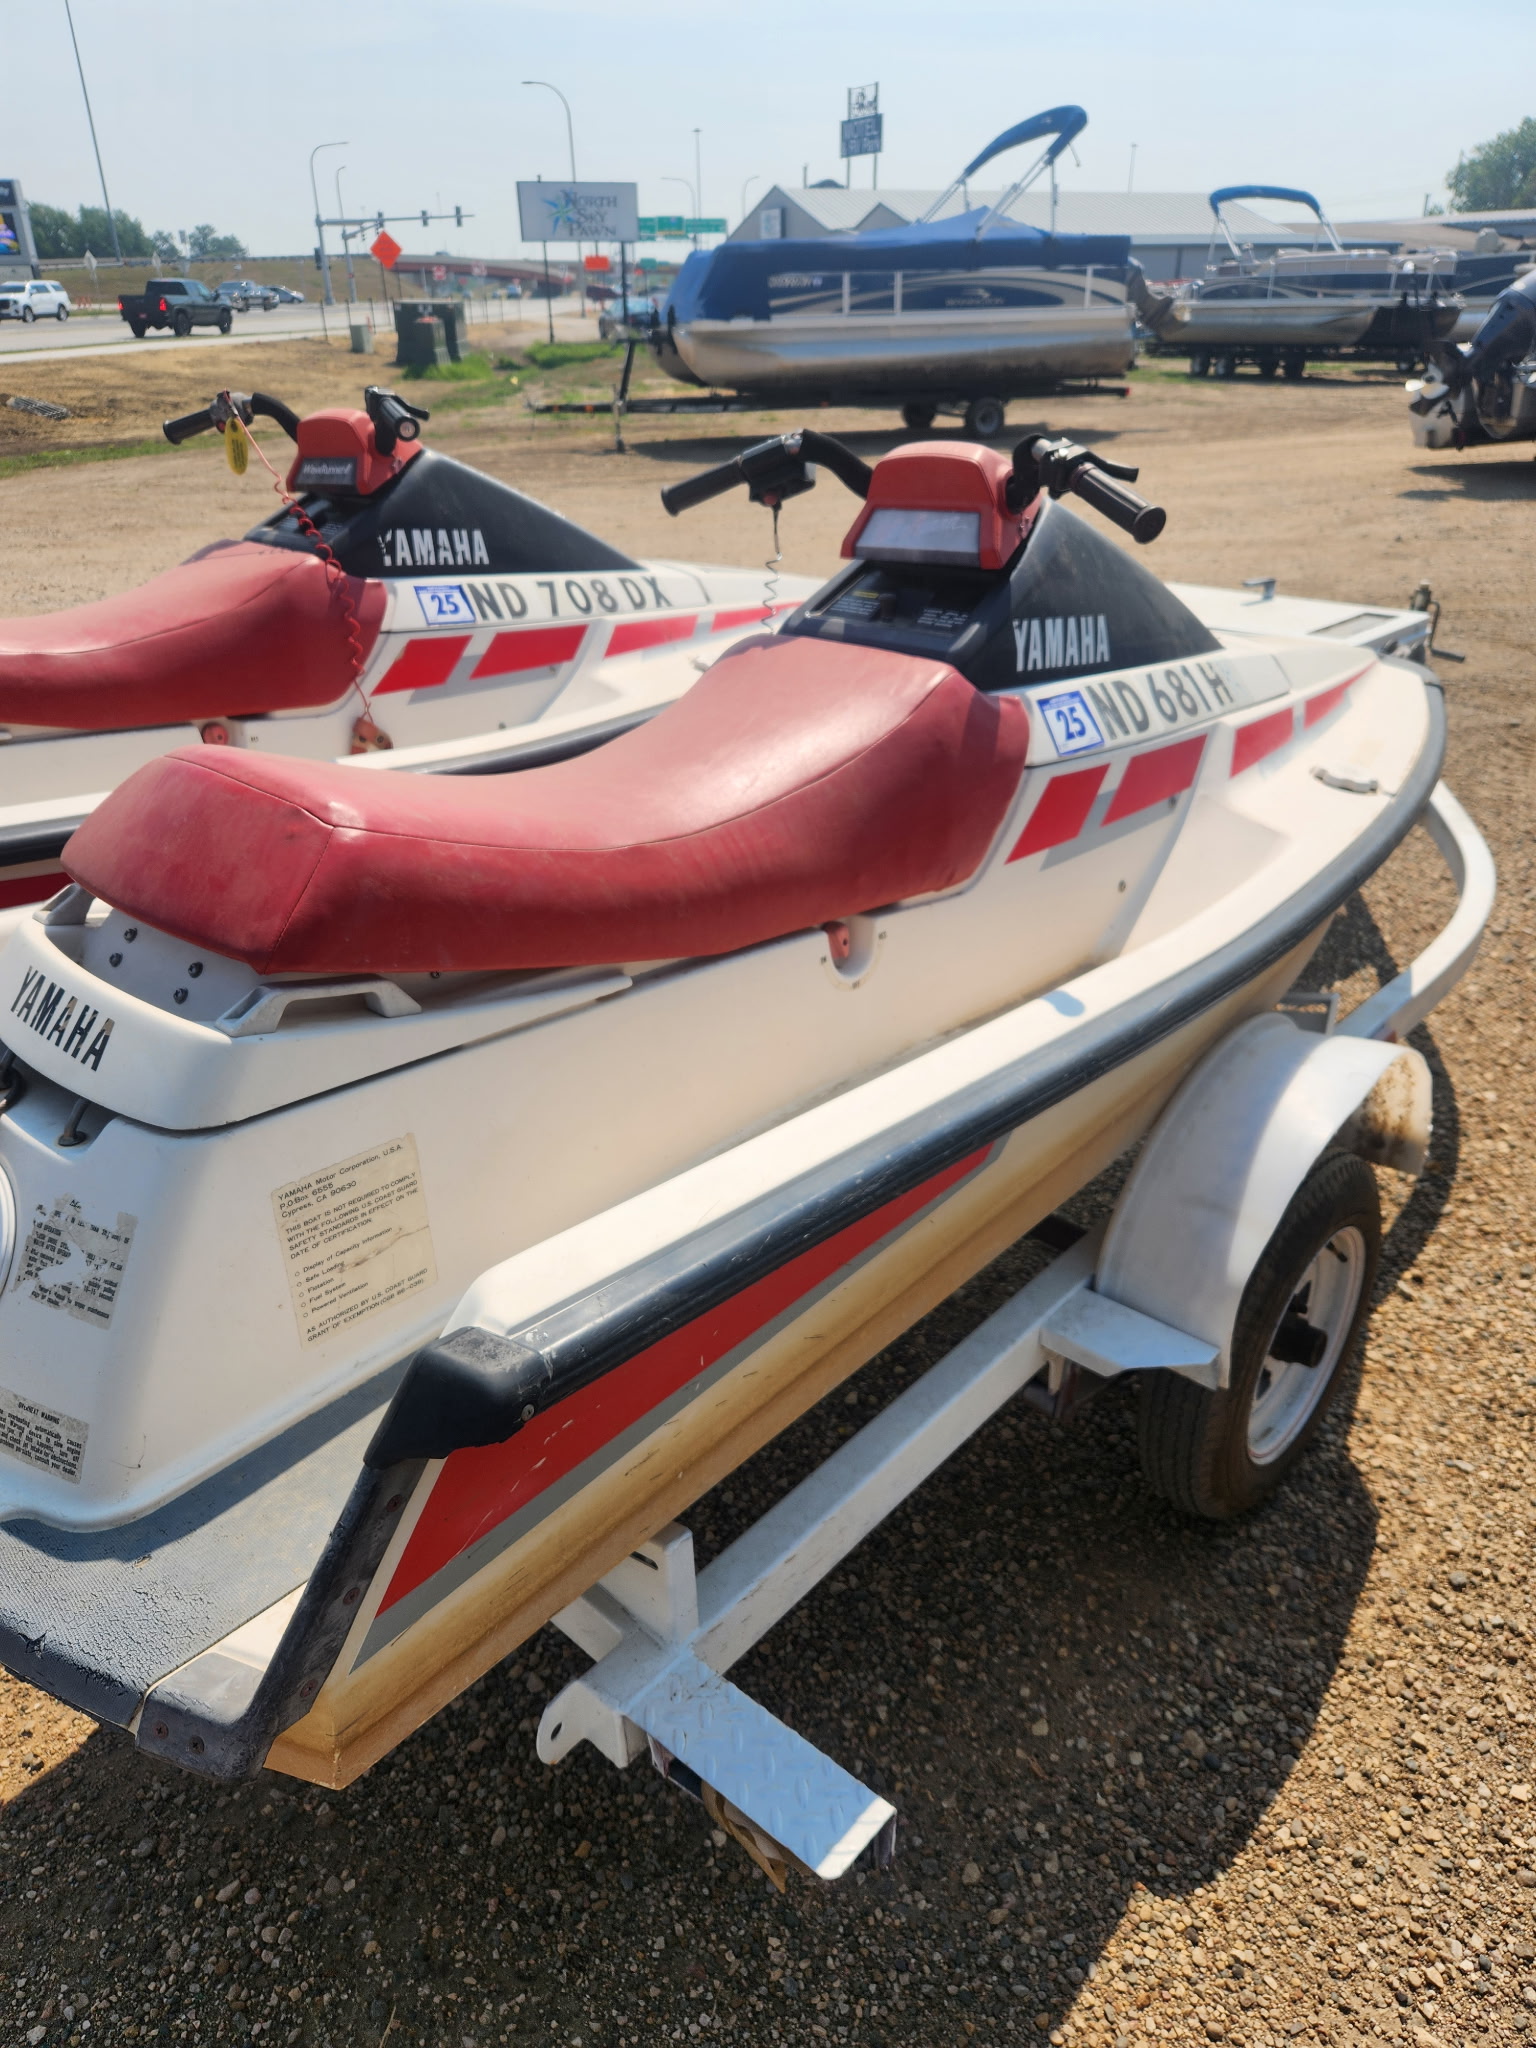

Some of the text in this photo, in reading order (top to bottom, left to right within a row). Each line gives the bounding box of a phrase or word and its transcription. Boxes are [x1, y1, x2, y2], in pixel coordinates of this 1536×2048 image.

[560, 188, 617, 208] NORTH
[575, 207, 608, 223] SKY
[567, 221, 617, 237] PAWN
[377, 528, 490, 567] YAMAHA
[430, 593, 460, 616] 25
[467, 582, 529, 621] ND
[535, 579, 619, 617] 708
[1012, 613, 1111, 673] YAMAHA
[1055, 706, 1086, 741] 25
[1085, 679, 1150, 741] ND
[10, 965, 115, 1072] YAMAHA
[278, 1182, 313, 1201] YAMAHA
[315, 1172, 337, 1185] Motor
[339, 1154, 381, 1175] Corporation,
[311, 1182, 334, 1196] 6555
[281, 1180, 357, 1218] Cypress, CA 90630
[285, 1172, 416, 1235] THIS BOAT IS NOT REQUIRED TO COMPLY
[287, 1231, 304, 1243] WITH
[306, 1224, 320, 1236] THE
[321, 1206, 360, 1228] FOLLOWING
[374, 1190, 396, 1203] COAST
[396, 1180, 418, 1193] GUARD
[289, 1187, 419, 1251] SAFETY STANDARDS IN EFFECT ON THE
[290, 1246, 310, 1260] DATE
[311, 1241, 321, 1249] OF
[303, 1259, 325, 1273] Display
[335, 1242, 361, 1257] Capacity
[361, 1227, 393, 1244] Information
[305, 1261, 345, 1283] Safe Loading
[307, 1277, 334, 1294] Flotation
[306, 1325, 317, 1335] AS
[318, 1304, 359, 1328] AUTHORIZED
[360, 1298, 370, 1307] BY
[384, 1279, 406, 1294] COAST
[407, 1267, 428, 1282] GUARD
[309, 1282, 347, 1304] Fuel System
[311, 1282, 369, 1313] Powered Ventilation
[307, 1326, 331, 1342] GRANT
[332, 1321, 342, 1329] OF
[343, 1301, 380, 1323] EXEMPTION
